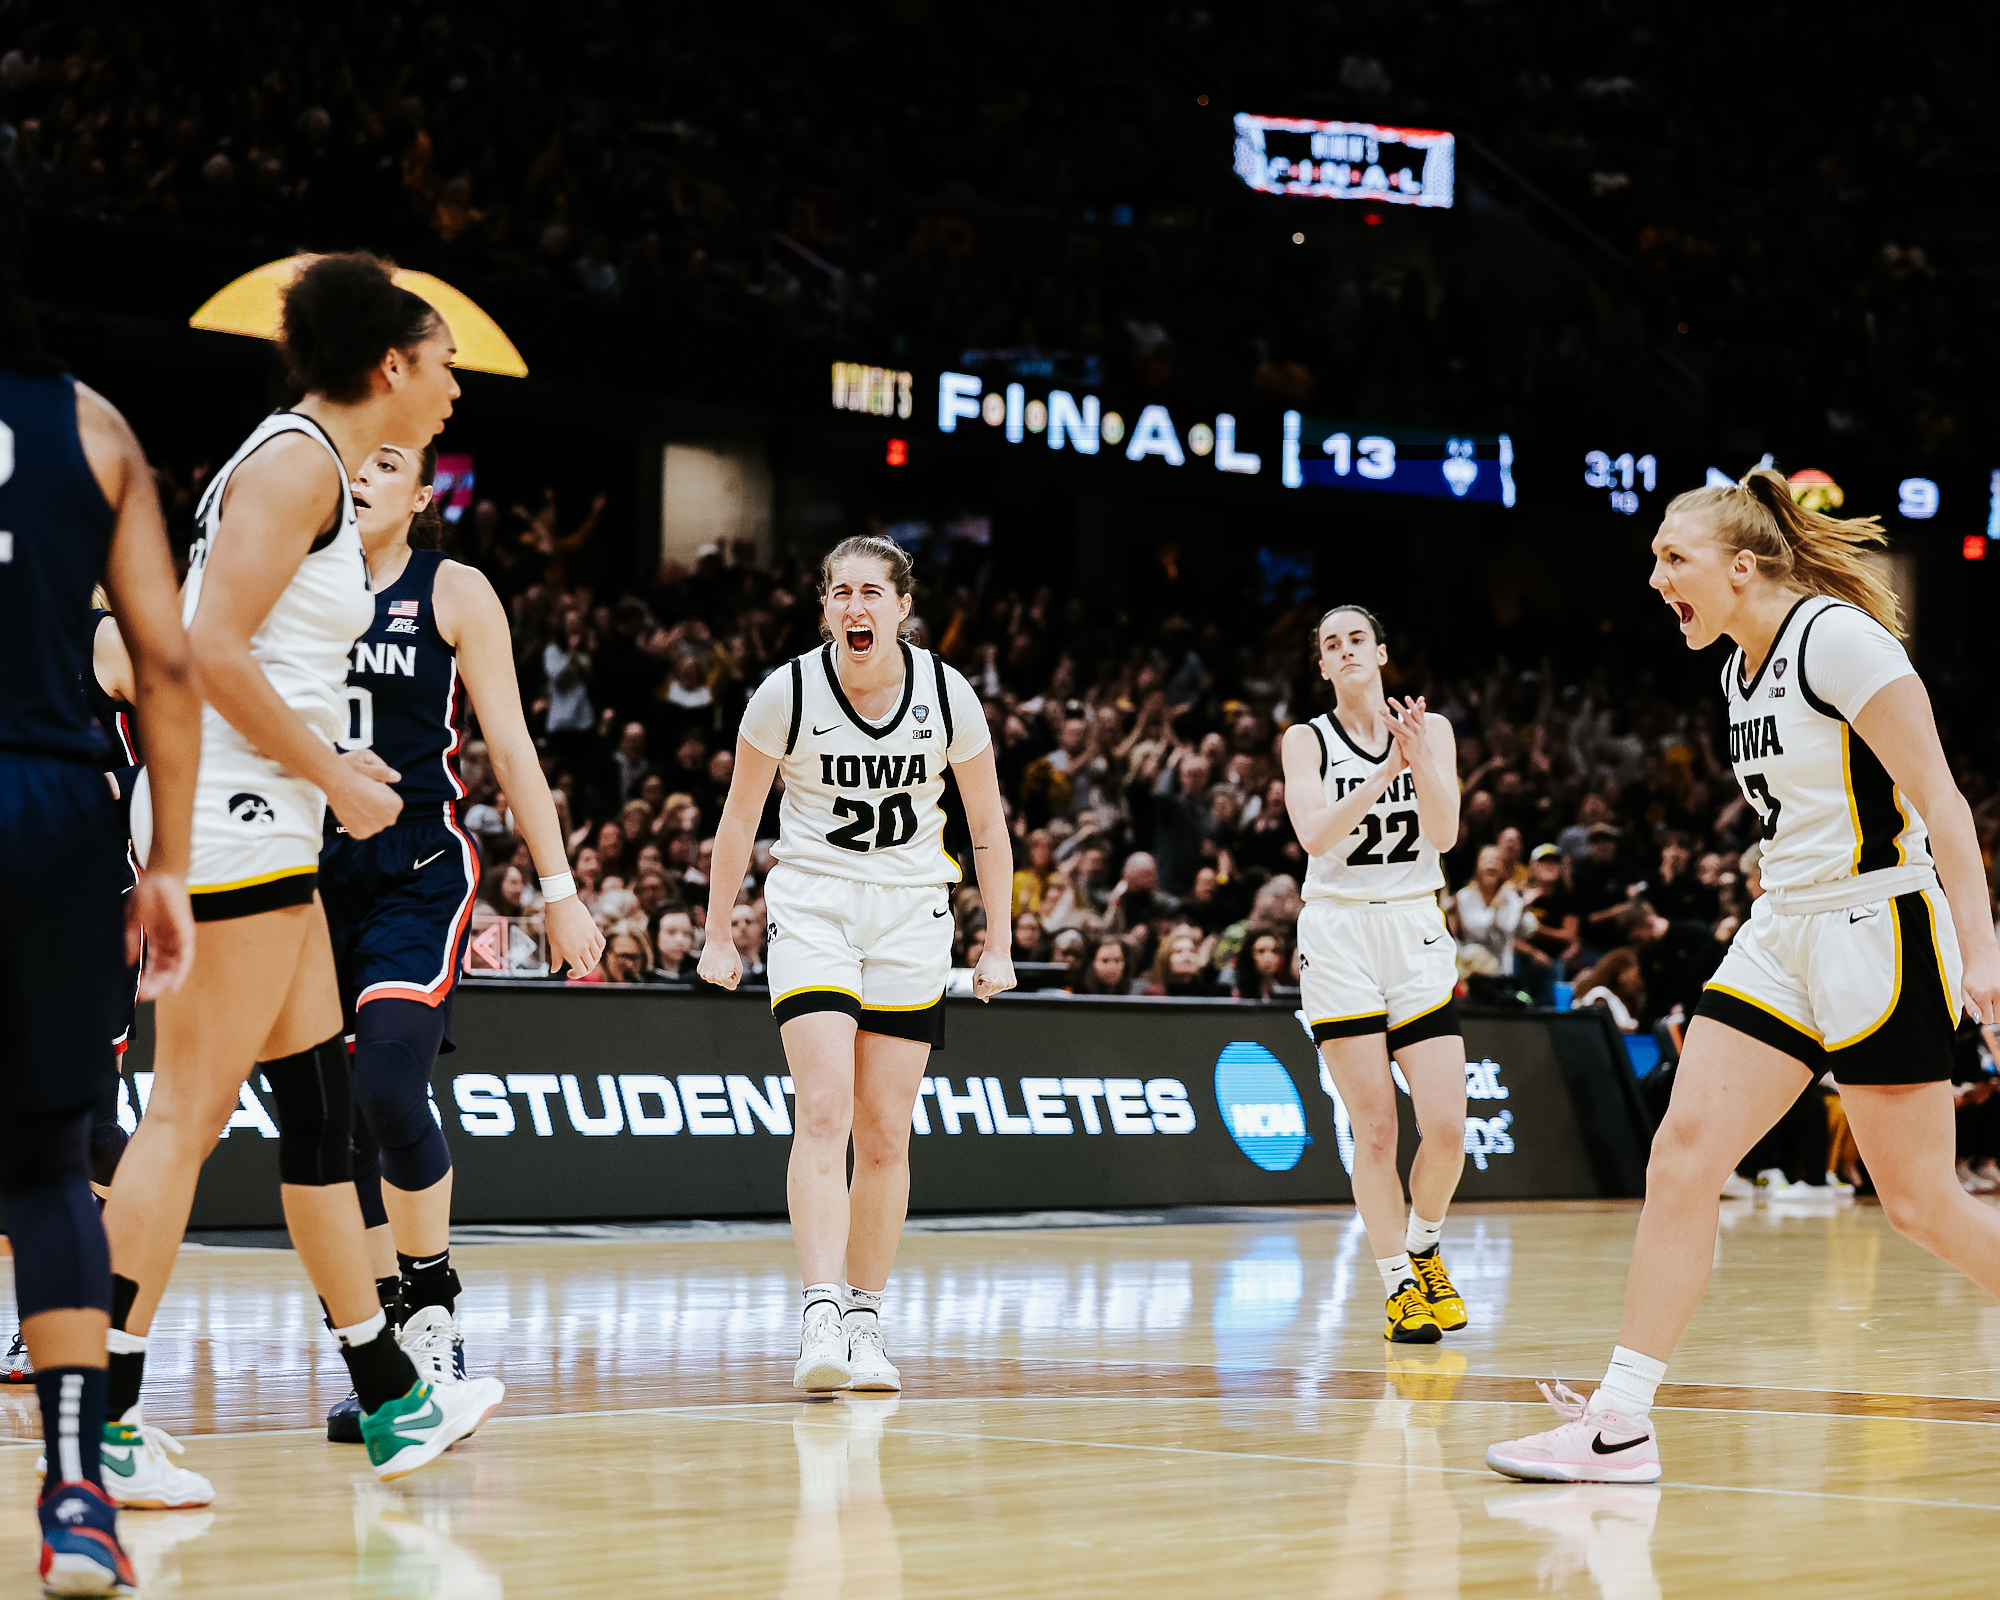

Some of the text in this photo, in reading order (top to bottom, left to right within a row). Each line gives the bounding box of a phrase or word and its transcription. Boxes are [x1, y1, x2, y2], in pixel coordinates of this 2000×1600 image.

[1322, 432, 1397, 480] 13
[1585, 450, 1657, 492] 3:11
[1898, 477, 1940, 519] 9
[1730, 715, 1784, 764] OWA
[819, 753, 928, 790] IOWA
[825, 792, 918, 852] 20
[1346, 809, 1421, 867] 22
[911, 1076, 1197, 1135] THLETES
